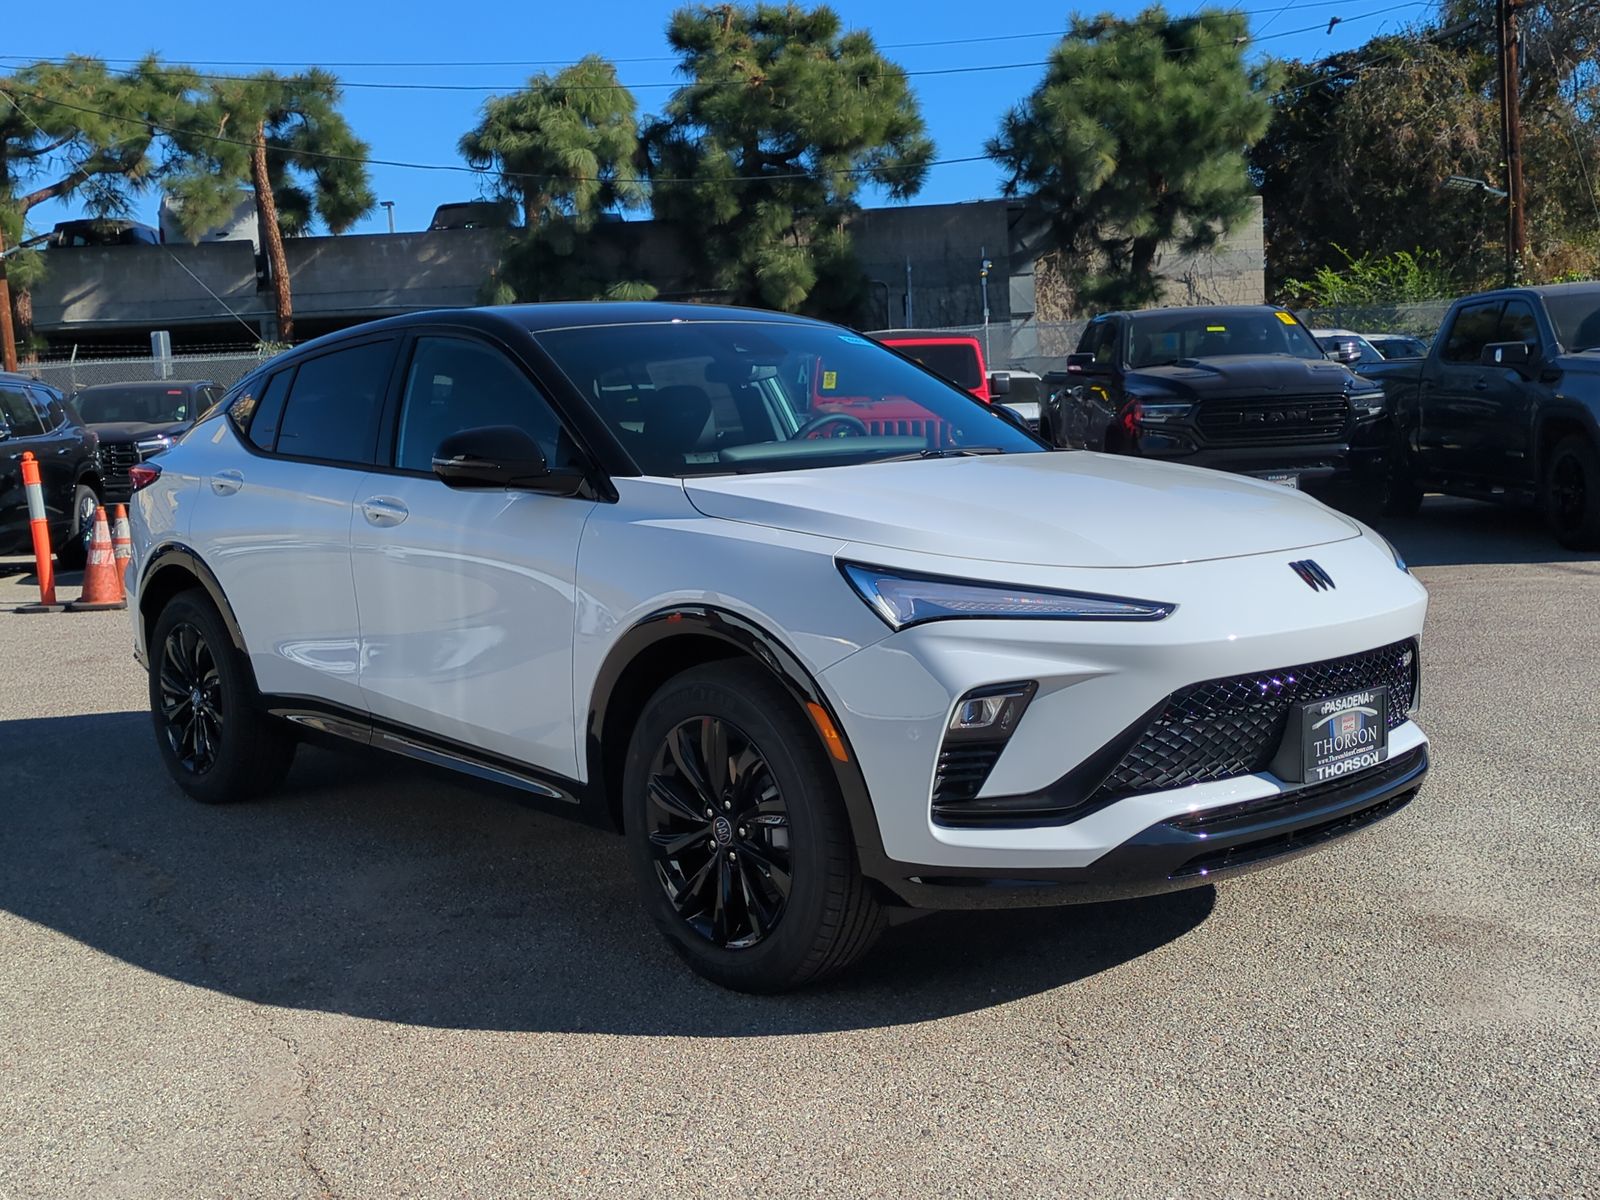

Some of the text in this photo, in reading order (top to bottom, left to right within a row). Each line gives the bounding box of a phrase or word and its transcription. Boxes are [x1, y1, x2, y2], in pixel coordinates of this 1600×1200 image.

[1324, 692, 1370, 714] PASADENA
[1314, 725, 1378, 757] THORSON
[1316, 751, 1379, 780] THORSON
